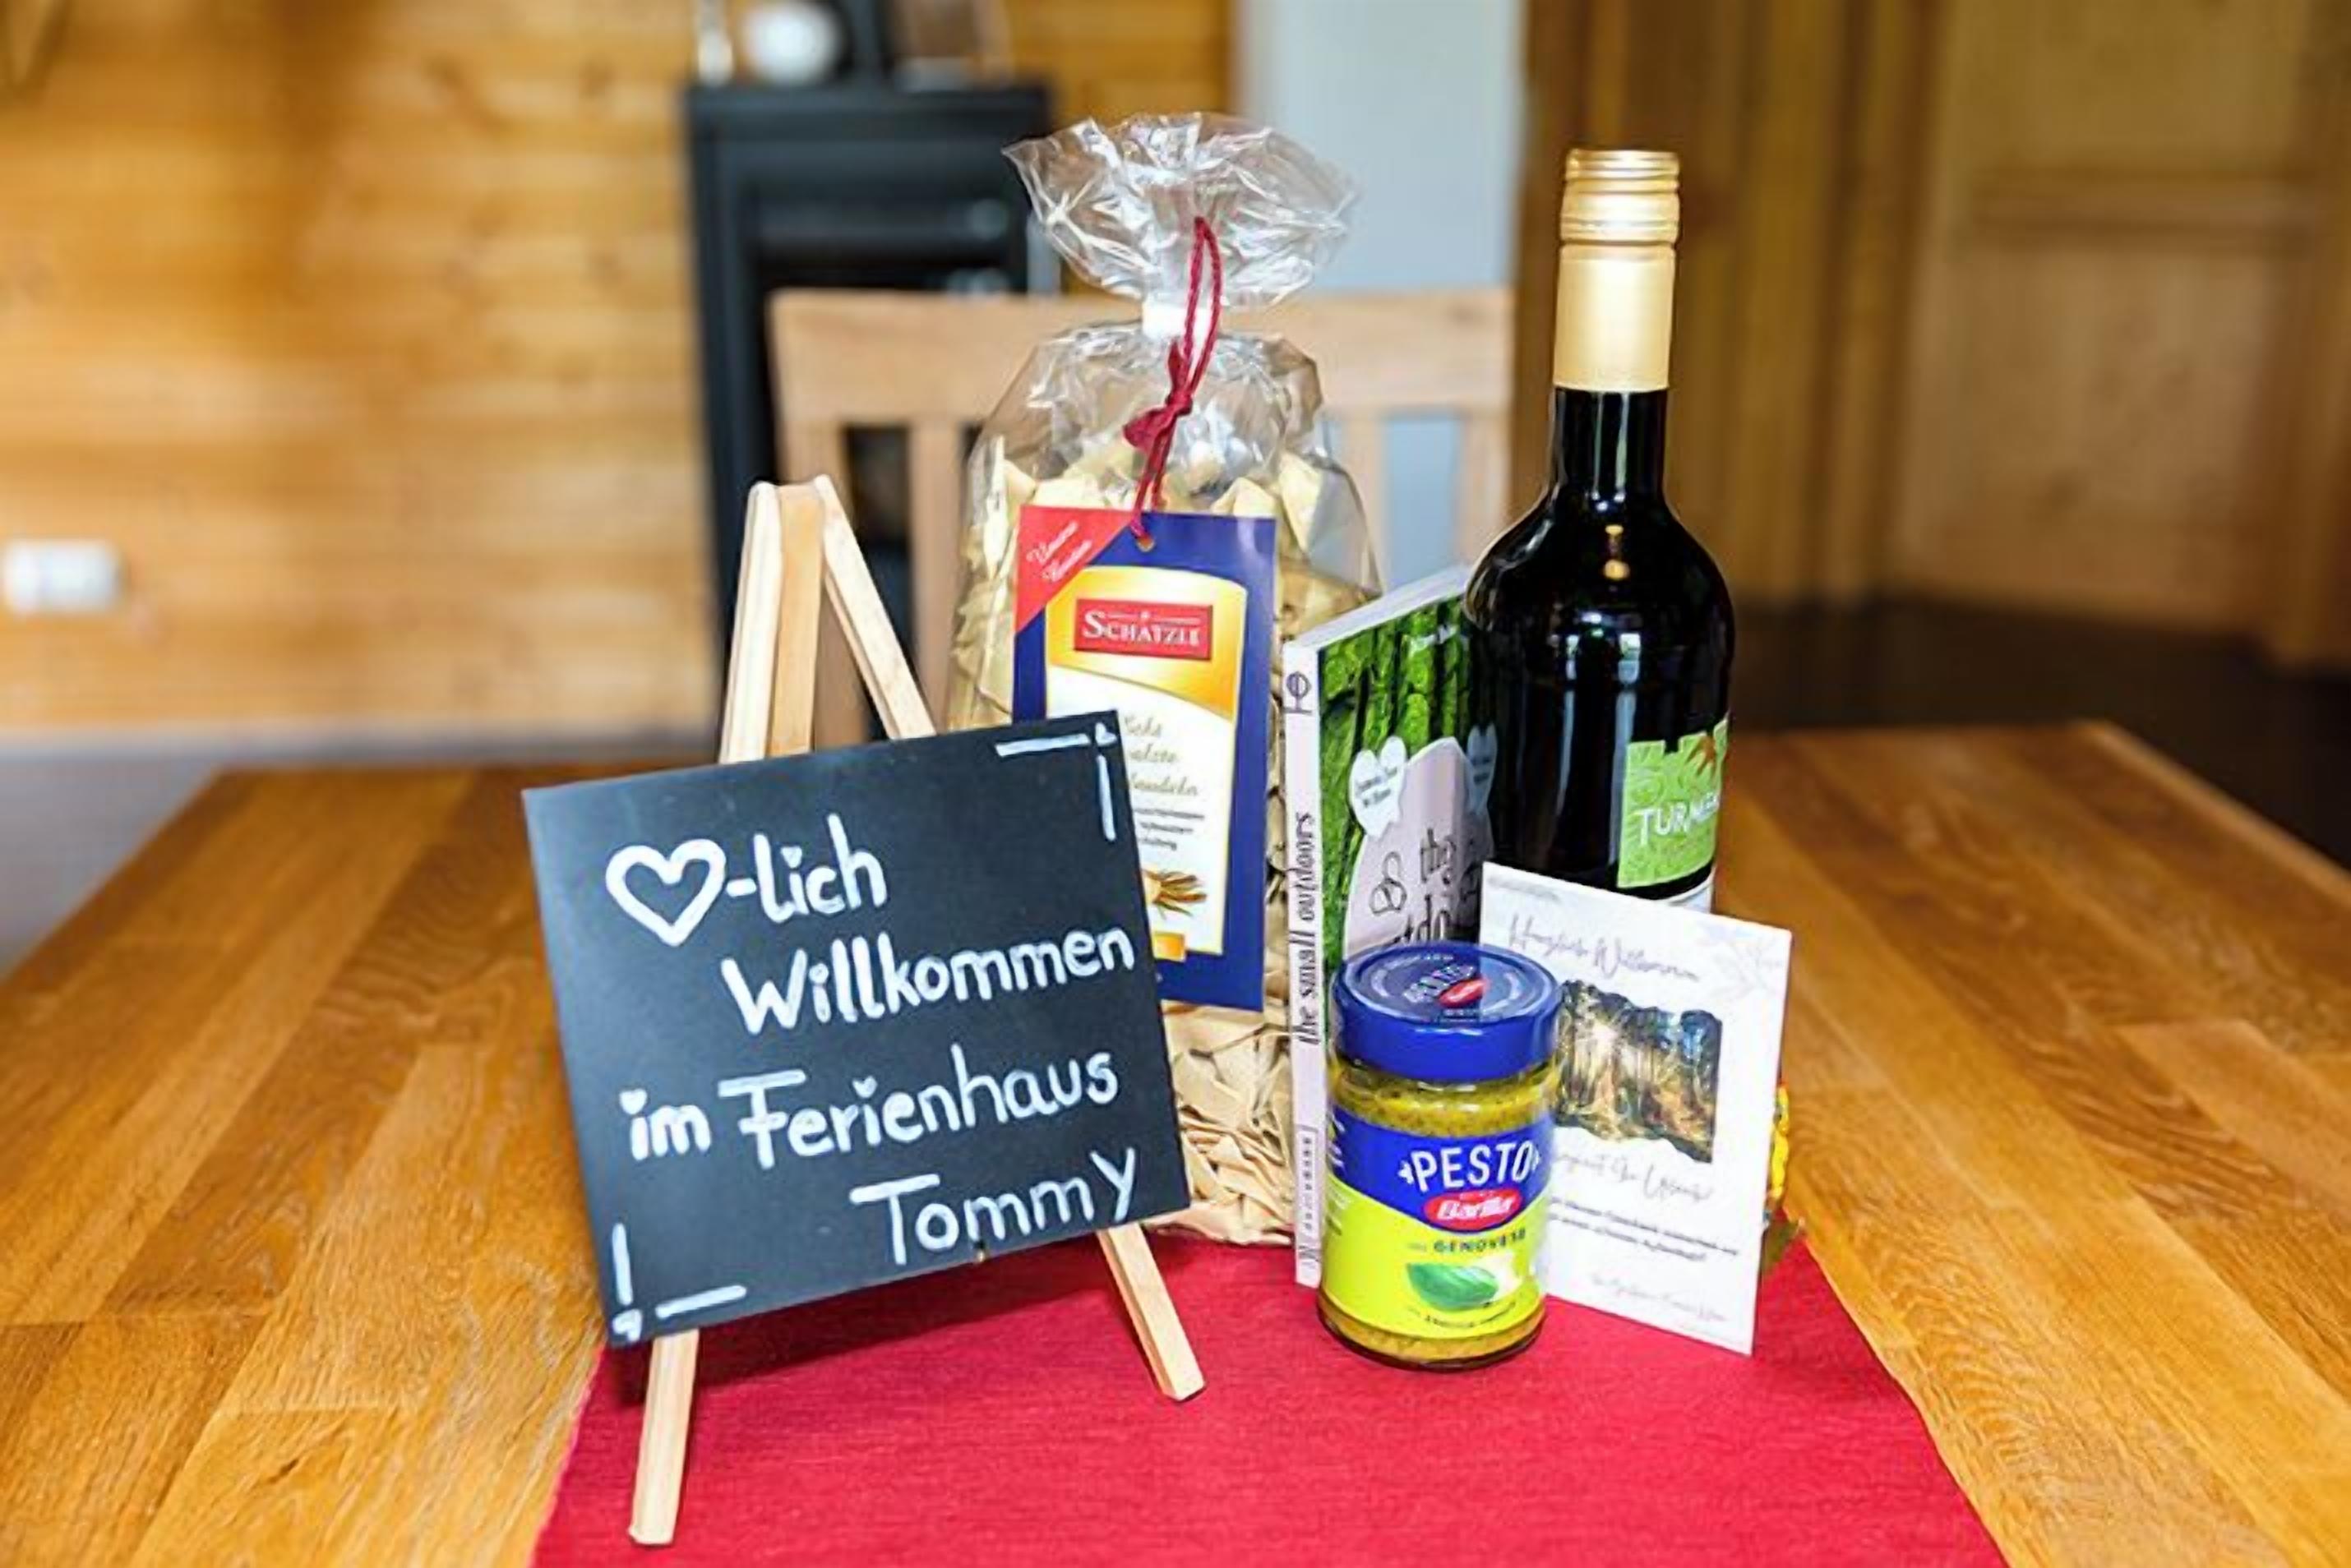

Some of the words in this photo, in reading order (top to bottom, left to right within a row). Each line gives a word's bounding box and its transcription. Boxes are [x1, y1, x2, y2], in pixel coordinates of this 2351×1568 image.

[721, 924, 1135, 1035] Willkommen
[1288, 929, 1317, 999] small
[618, 1088, 711, 1161] im
[718, 1044, 1120, 1169] Ferienhaus
[850, 1148, 1138, 1266] Tommy
[1411, 1140, 1532, 1193] PESTO
